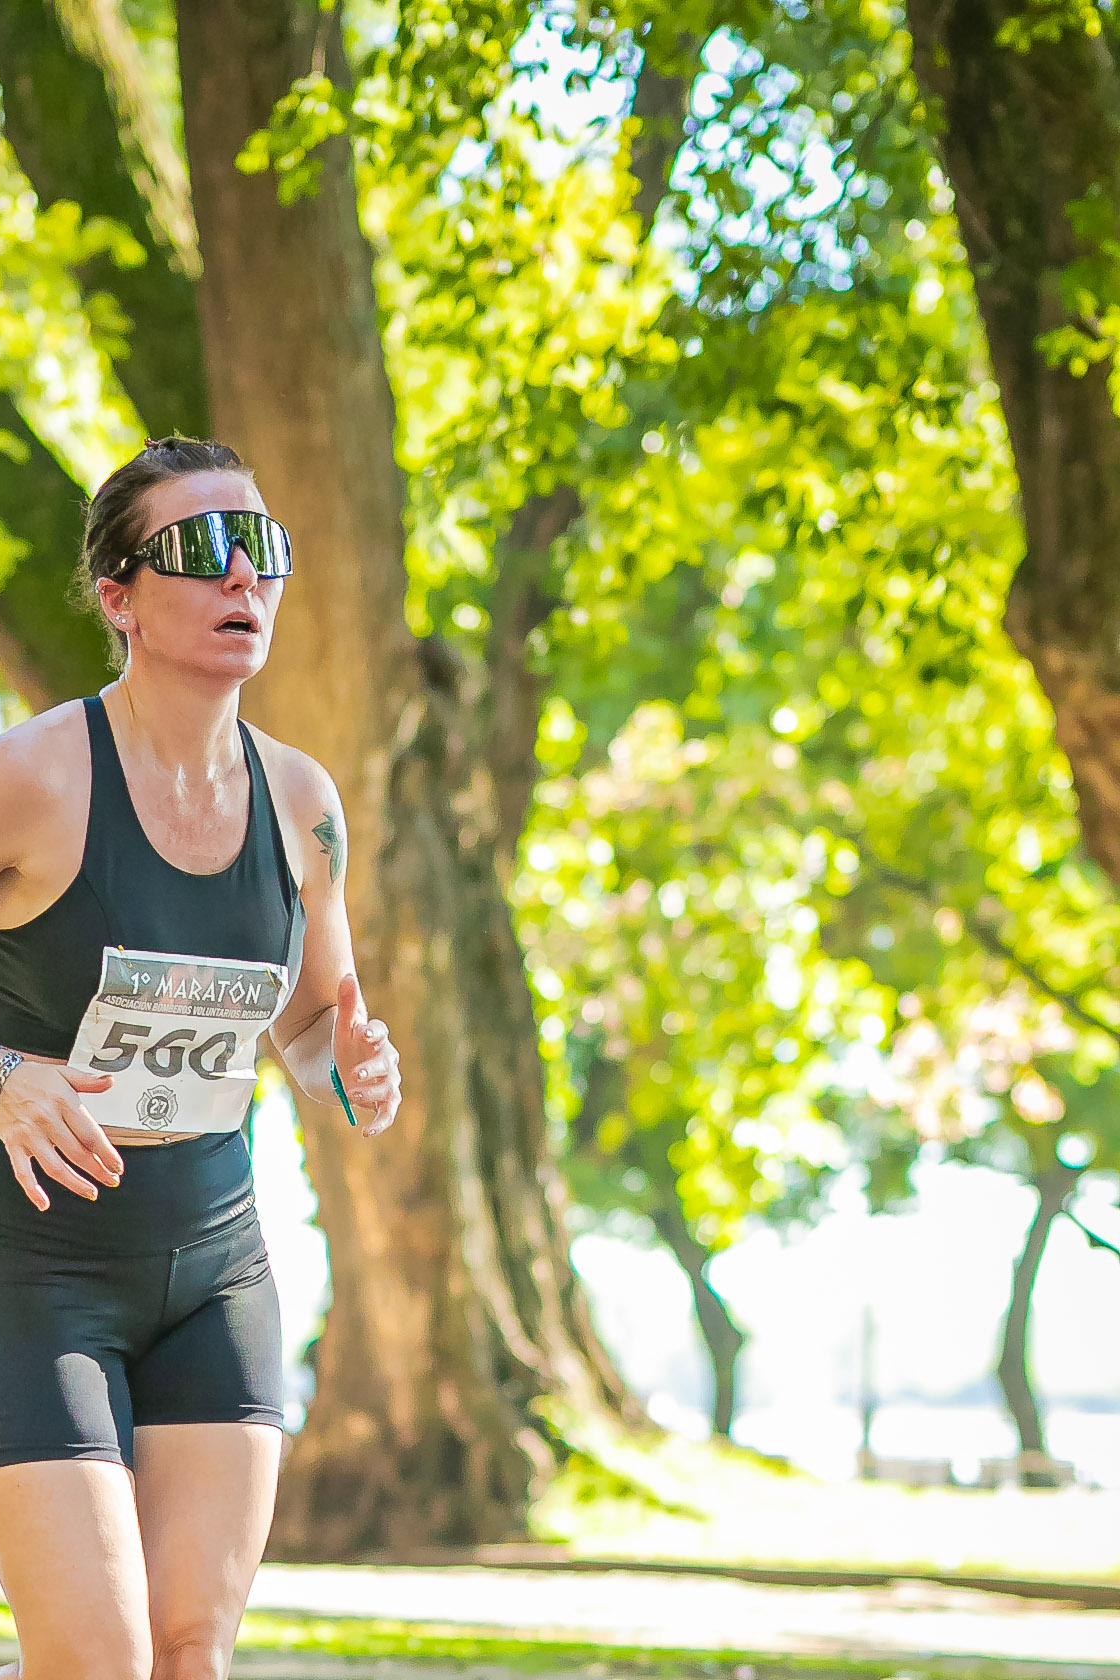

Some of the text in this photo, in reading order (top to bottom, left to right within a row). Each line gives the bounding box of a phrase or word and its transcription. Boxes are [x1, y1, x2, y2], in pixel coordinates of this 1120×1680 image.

[155, 973, 262, 1005] MARATÓN
[152, 1002, 192, 1017] BOMBEROS
[192, 1006, 241, 1019] VOLUNTARIOS
[89, 1021, 237, 1081] 560
[150, 1098, 168, 1114] 27
